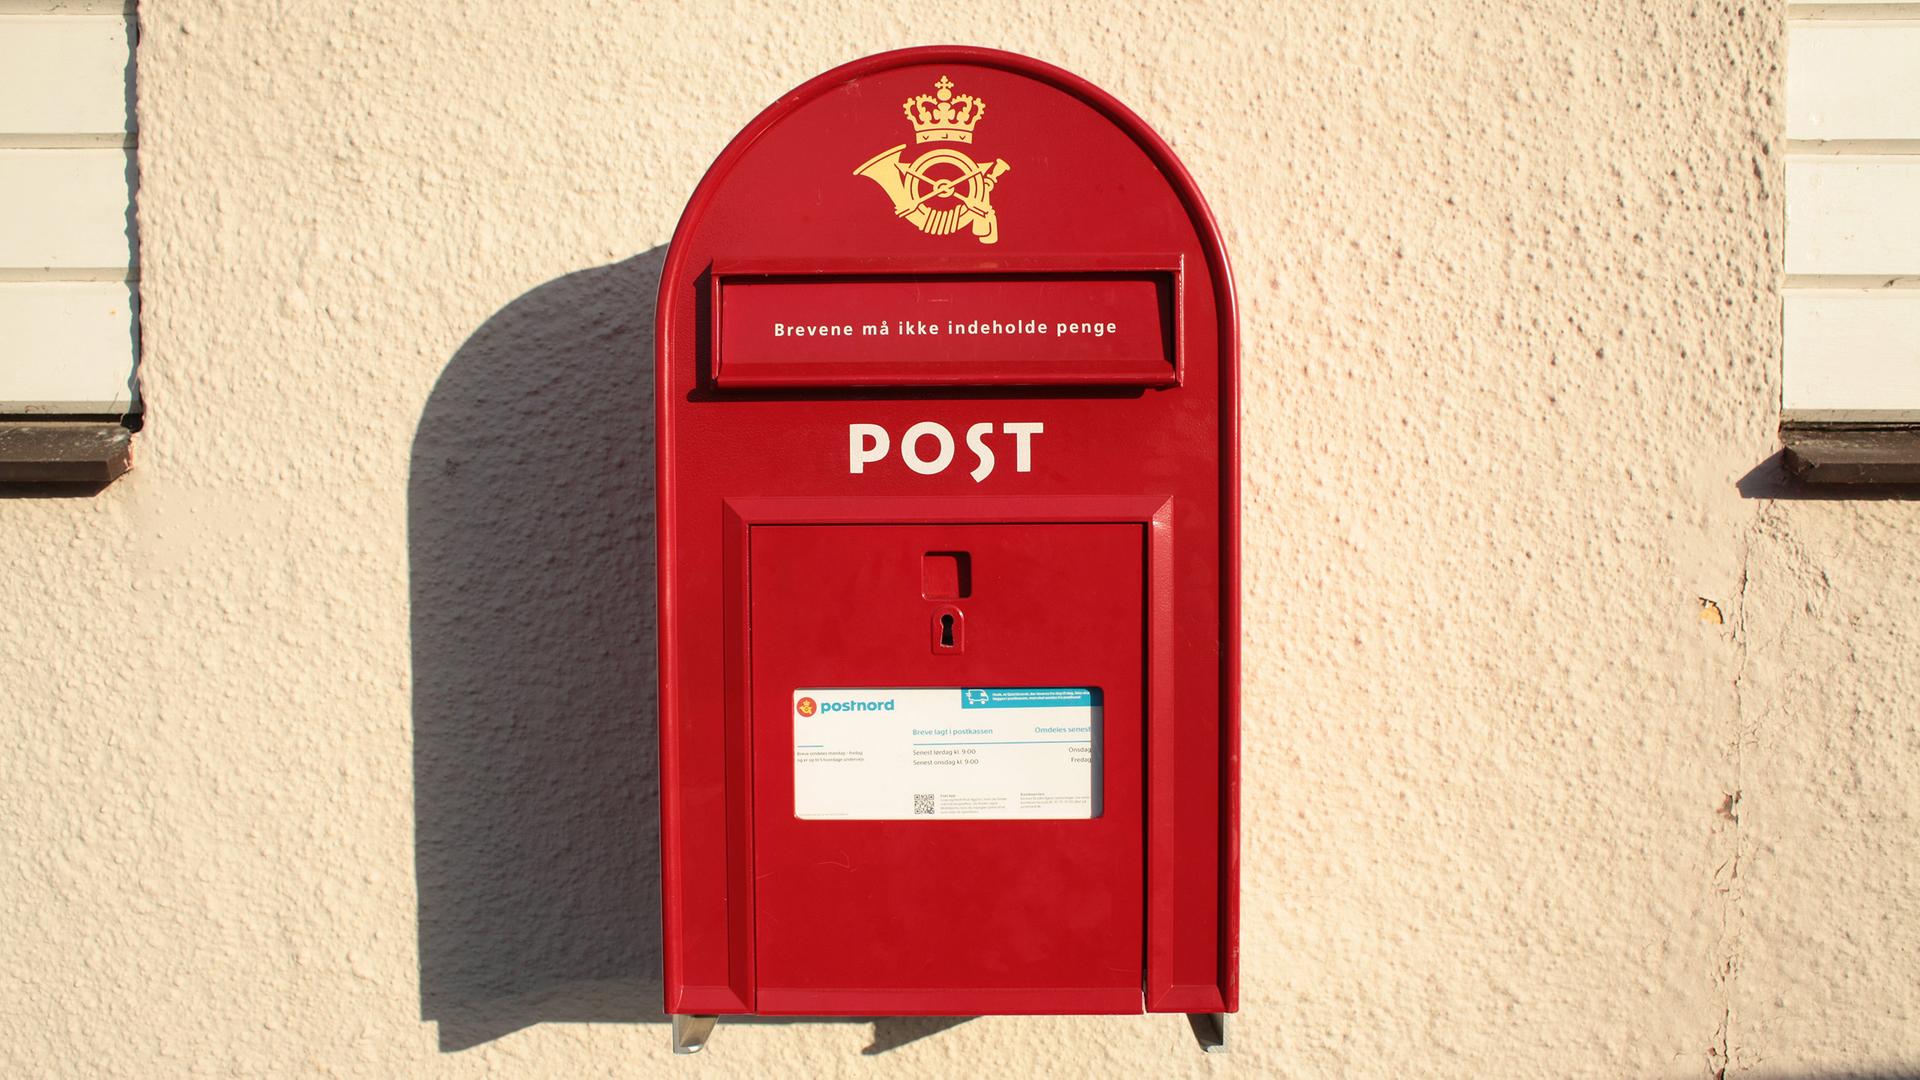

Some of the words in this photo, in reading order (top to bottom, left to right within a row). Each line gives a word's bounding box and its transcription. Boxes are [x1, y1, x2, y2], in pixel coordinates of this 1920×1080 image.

[774, 323, 853, 337] Brevene
[862, 320, 889, 336] må
[898, 320, 939, 336] ikke
[948, 319, 1048, 335] indeholde
[1056, 320, 1117, 337] penge
[849, 421, 1044, 483] POST
[820, 699, 895, 714] postnord
[934, 728, 949, 737] lagt
[953, 728, 993, 736] postkassen
[933, 748, 953, 756] lørdag
[933, 758, 956, 766] onsdag
